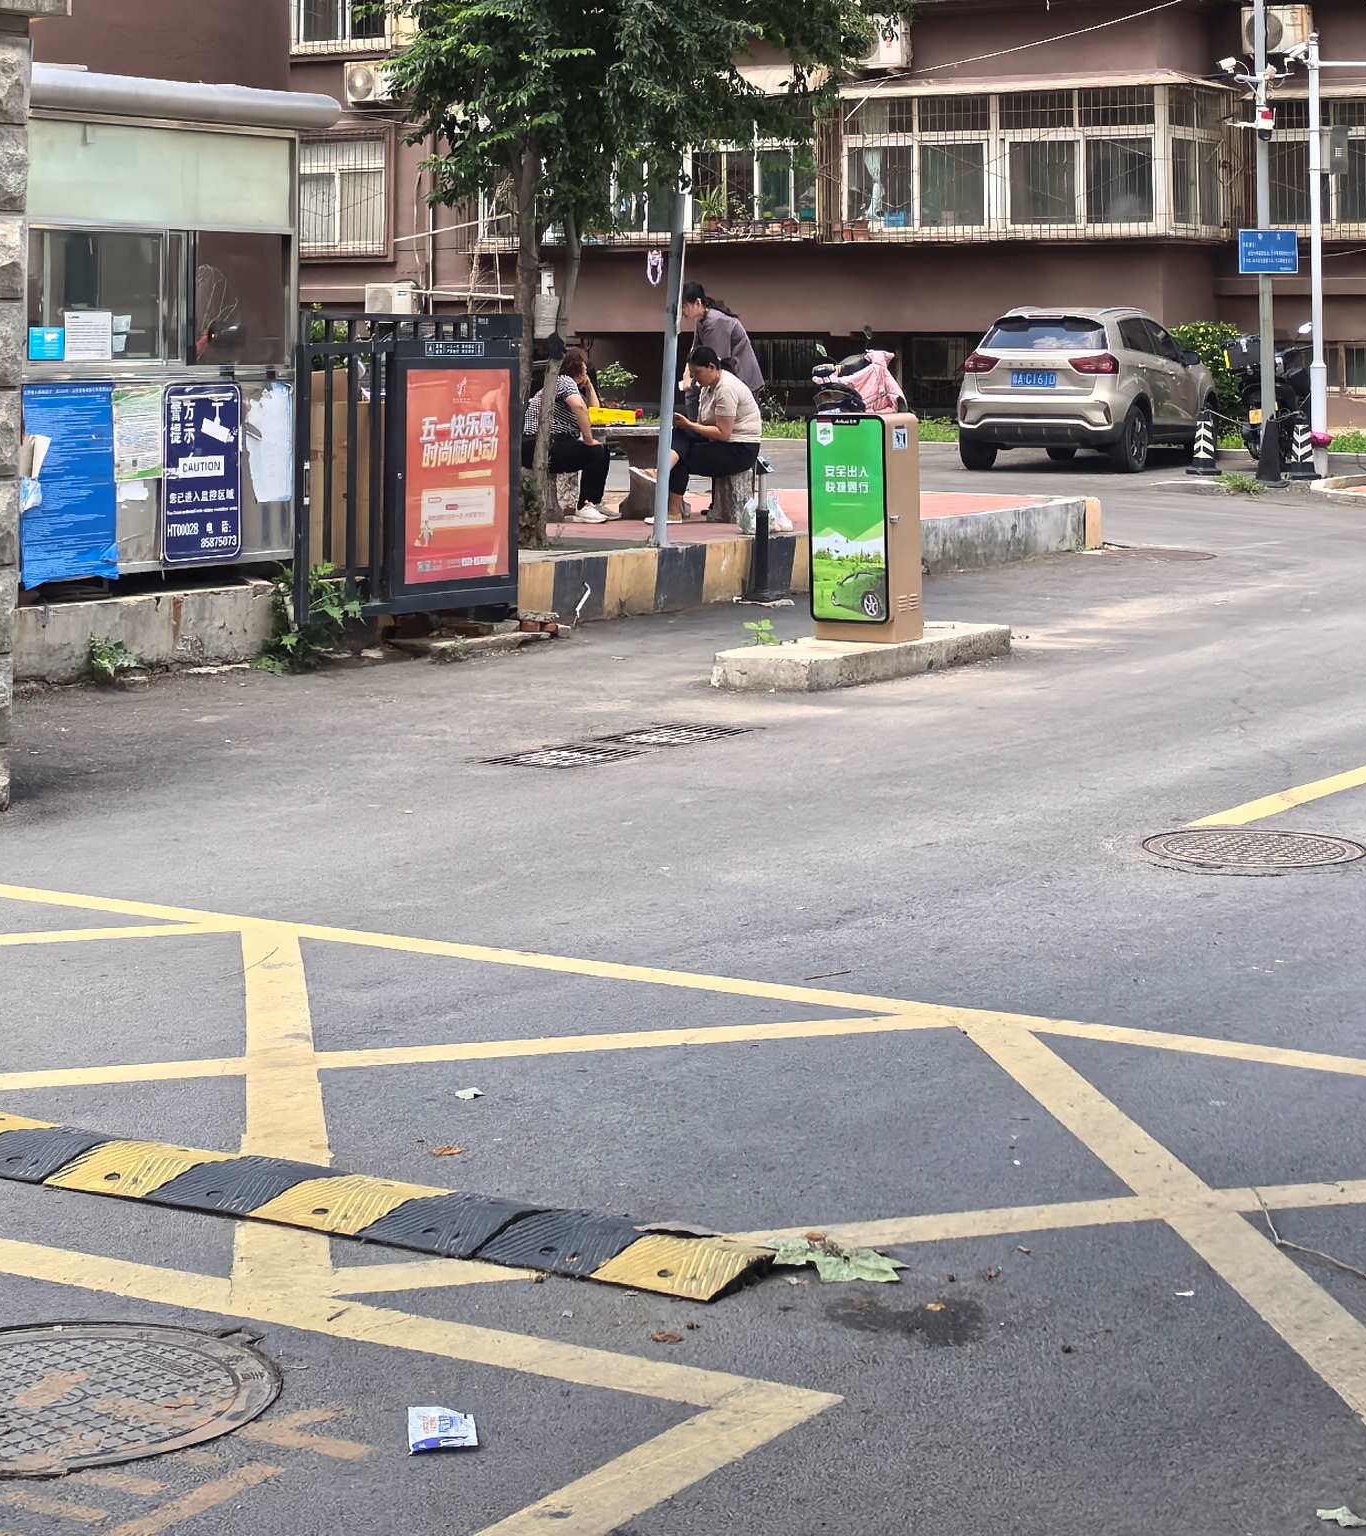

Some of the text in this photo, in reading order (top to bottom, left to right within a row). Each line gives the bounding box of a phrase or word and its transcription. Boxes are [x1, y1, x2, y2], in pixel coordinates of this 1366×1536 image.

[421, 436, 499, 468] 时尚随心动
[181, 460, 221, 473] CAUTION
[824, 464, 869, 478] 安全出入
[169, 488, 235, 504] 您已进入监控区域
